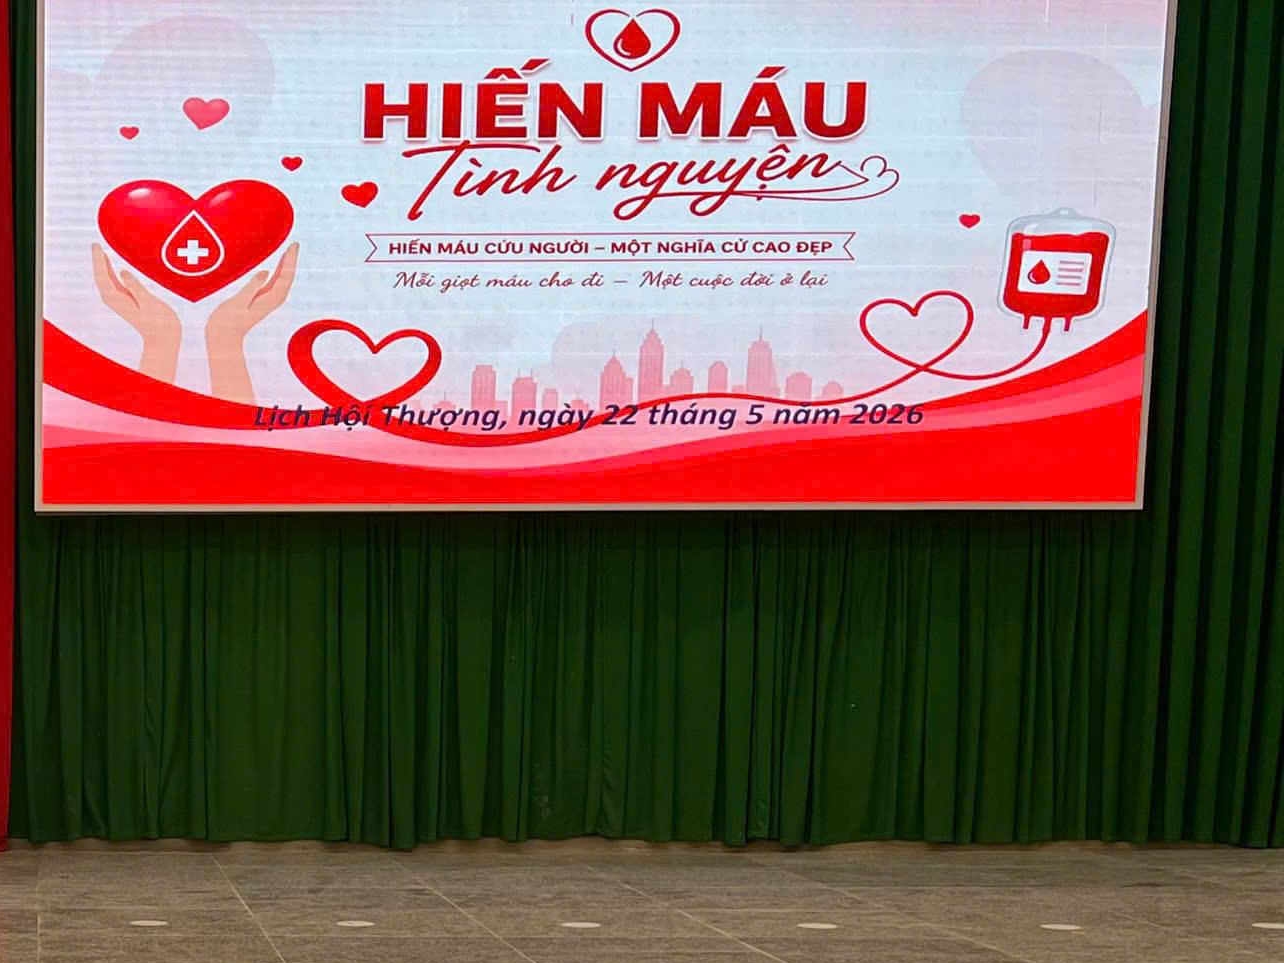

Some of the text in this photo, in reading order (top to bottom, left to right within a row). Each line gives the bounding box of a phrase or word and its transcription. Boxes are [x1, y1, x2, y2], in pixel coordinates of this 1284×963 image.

[362, 59, 868, 140] HIẾN MÁU
[402, 141, 846, 220] Tình nguyện
[389, 239, 431, 255] HIẾN
[437, 240, 479, 255] MÁU
[484, 240, 524, 255] CỨU
[529, 240, 589, 255] NGƯỜI
[611, 239, 652, 256] MỘT
[657, 239, 716, 254] NGHĨA
[721, 238, 748, 254] CỬ
[752, 241, 791, 254] CAO
[796, 241, 833, 256] ĐẸP
[393, 271, 435, 288] Mỗi
[441, 272, 480, 293] giọt
[485, 274, 532, 288] máu
[539, 271, 575, 288] cho
[581, 271, 604, 288] đi
[639, 270, 683, 289] Một
[689, 274, 733, 289] cuộc
[740, 271, 774, 287] đời
[780, 272, 794, 286] ở
[799, 270, 829, 289] lại
[254, 402, 924, 432] Lịch Hội Thượng, ngày 22 tháng 5 năm 2026
